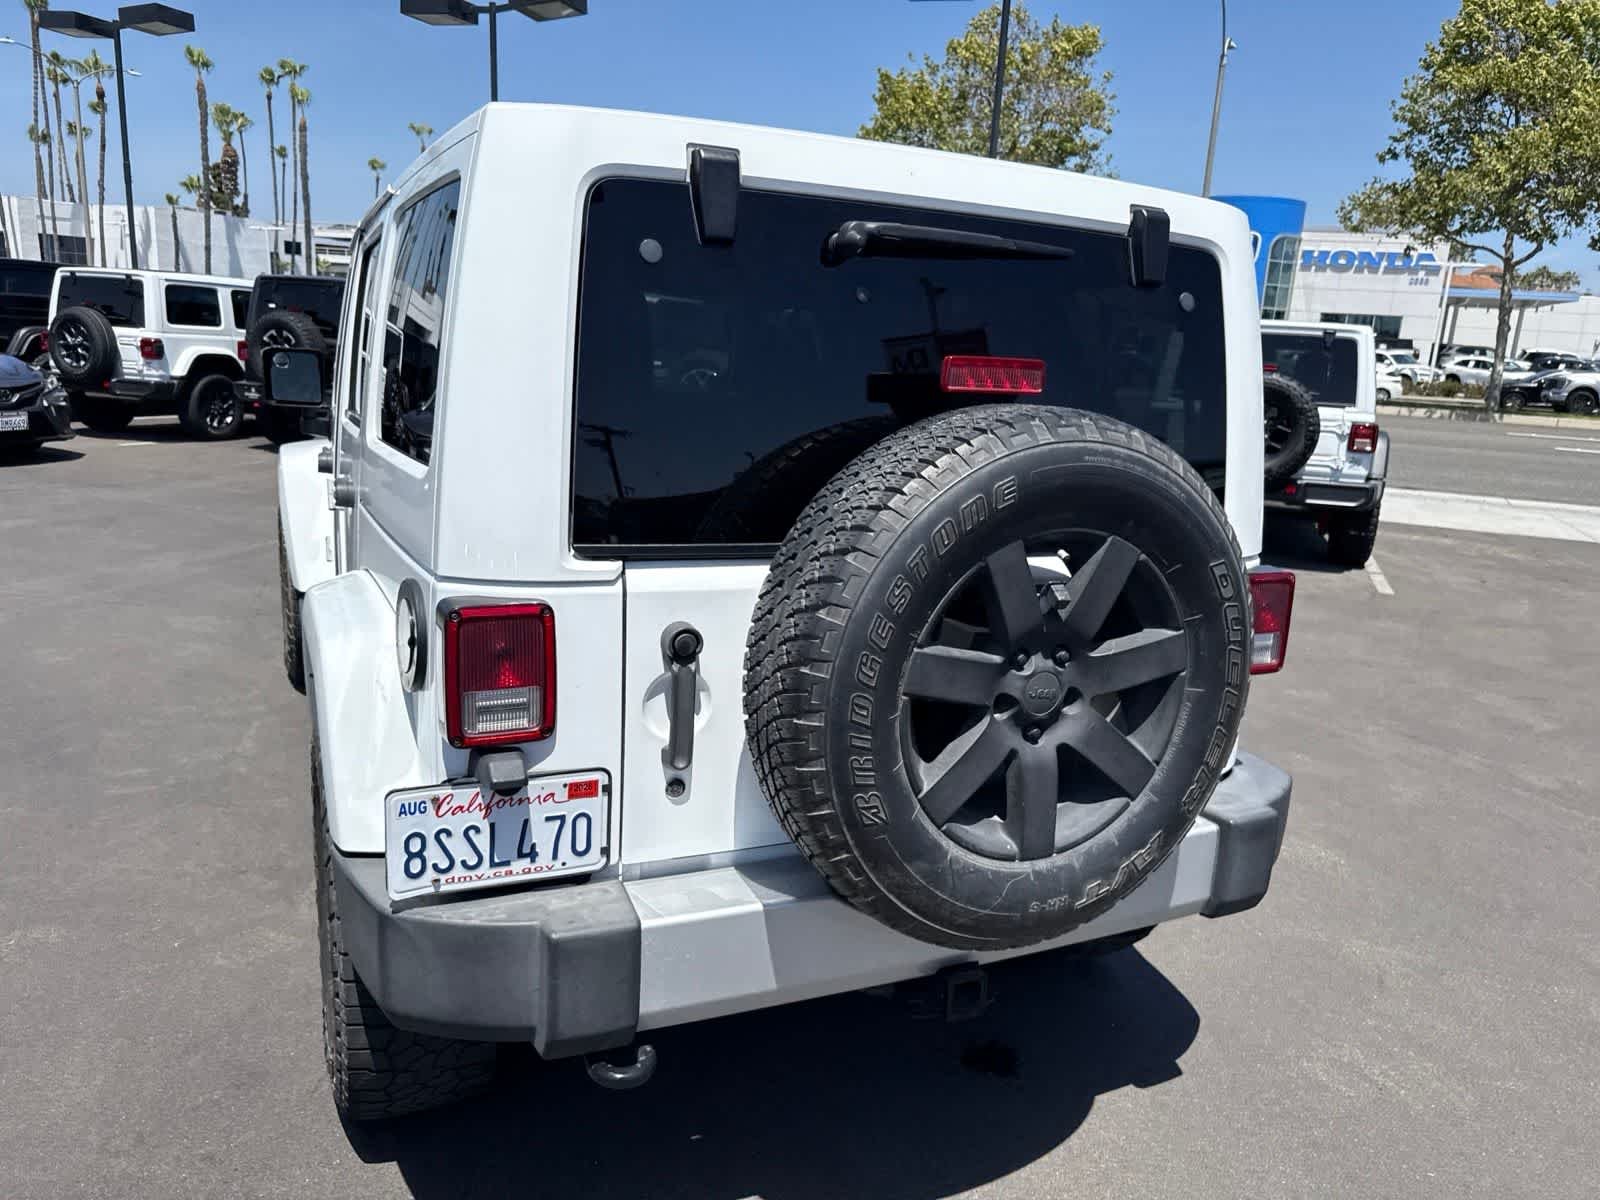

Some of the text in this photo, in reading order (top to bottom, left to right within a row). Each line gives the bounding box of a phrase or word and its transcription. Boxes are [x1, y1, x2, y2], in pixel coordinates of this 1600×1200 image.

[1301, 249, 1441, 275] HONDA
[851, 475, 1019, 829] BRIDGESTONE
[1183, 559, 1242, 818] DUELER
[398, 800, 428, 817] AUG
[434, 790, 570, 819] California
[403, 811, 592, 880] 8SSL470
[444, 863, 556, 885] dmv.ca.gov
